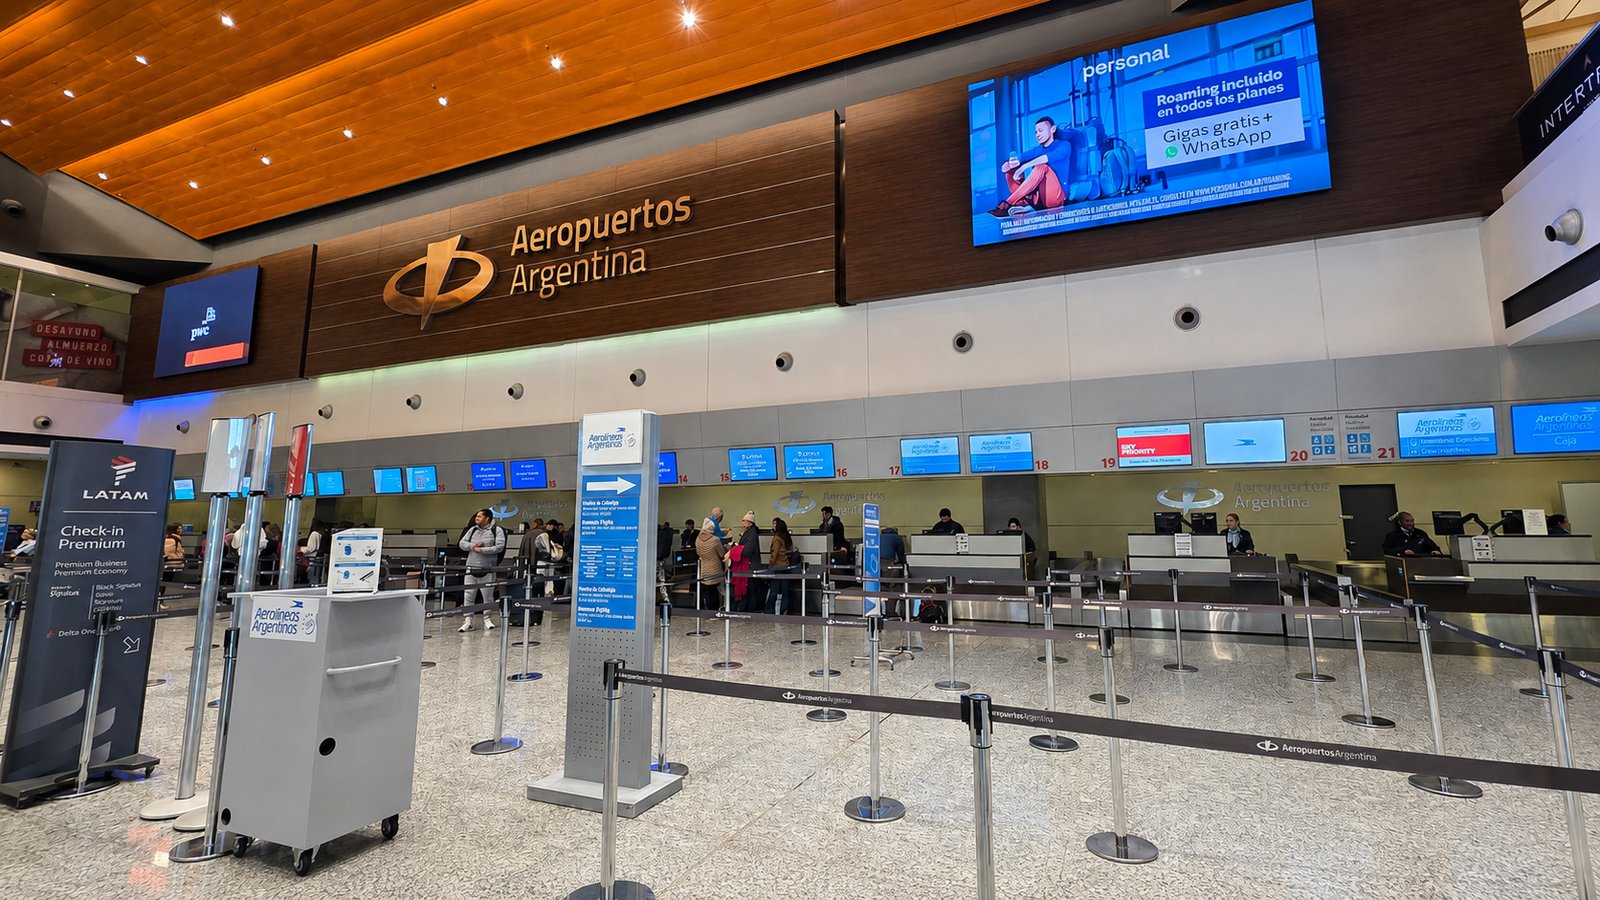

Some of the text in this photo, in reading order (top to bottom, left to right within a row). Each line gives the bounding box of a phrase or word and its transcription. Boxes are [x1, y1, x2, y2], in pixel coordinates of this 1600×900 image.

[1082, 43, 1171, 82] personal
[1156, 69, 1283, 107] Roaming incluido
[1157, 83, 1285, 118] en todos los planes
[1163, 124, 1209, 143] Gigas
[1213, 115, 1260, 136] gratis
[1182, 130, 1272, 156] WhatsApp
[510, 195, 692, 257] Aeropuertos
[509, 245, 647, 299] Argentina
[36, 324, 97, 337] DESAYUNO
[190, 325, 210, 341] pwc
[47, 340, 108, 352] ALMUERZO
[66, 355, 81, 365] DE
[86, 356, 113, 366] VINO
[1554, 435, 1577, 446] Caja
[1290, 450, 1309, 462] 20
[1377, 447, 1396, 459] 21
[1035, 460, 1049, 470] 18
[1101, 457, 1116, 468] 19
[836, 468, 848, 478] 16
[888, 466, 900, 476] 17
[720, 473, 730, 482] 15
[1233, 481, 1331, 495] Aeropuertos
[82, 489, 149, 501] LATAM
[1234, 496, 1311, 512] Argentina
[60, 525, 125, 537] Check-in
[58, 538, 126, 550] Premium
[55, 559, 128, 569] Premium Business
[54, 567, 129, 577] Premium Economy
[254, 607, 301, 623] Aerolíneas
[58, 629, 80, 637] Delta
[251, 620, 298, 636] Argentinas
